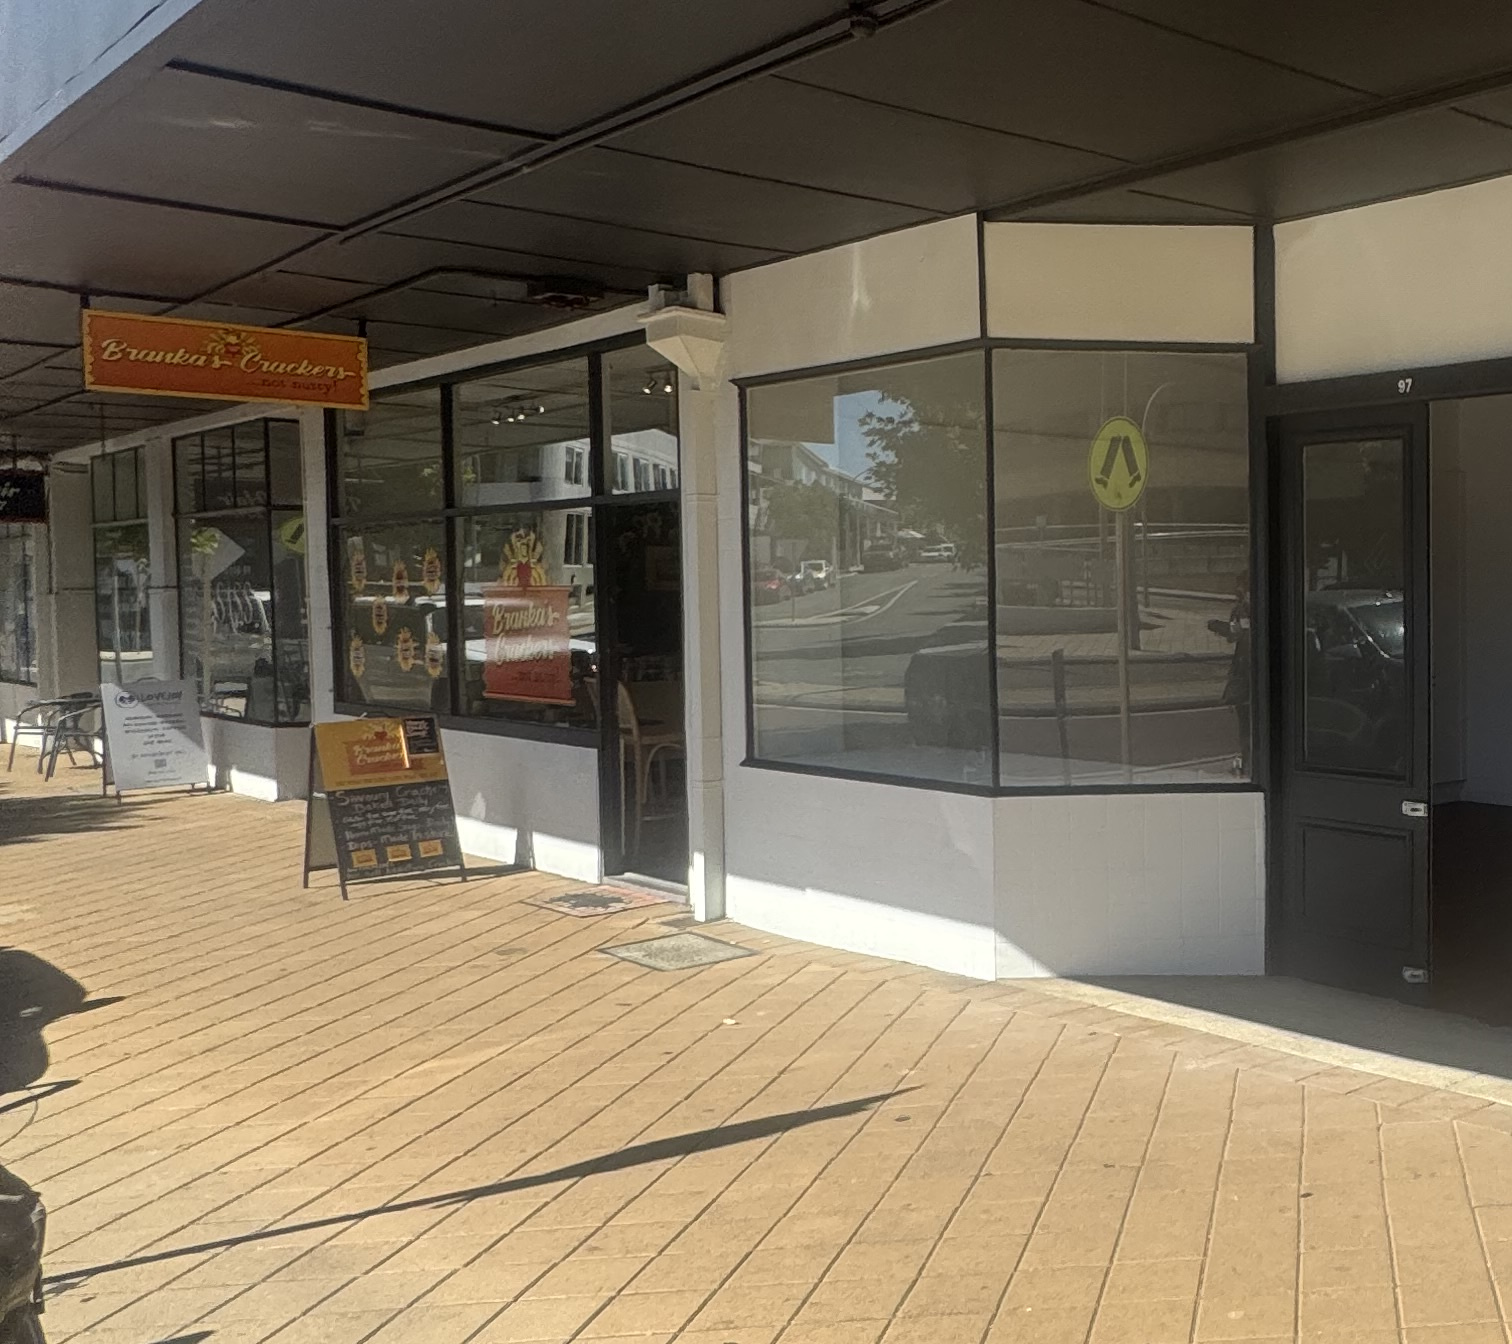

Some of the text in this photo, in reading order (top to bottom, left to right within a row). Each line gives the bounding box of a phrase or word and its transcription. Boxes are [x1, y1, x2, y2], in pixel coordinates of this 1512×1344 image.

[101, 338, 356, 380] Branka's Crackers
[1397, 377, 1413, 394] 97
